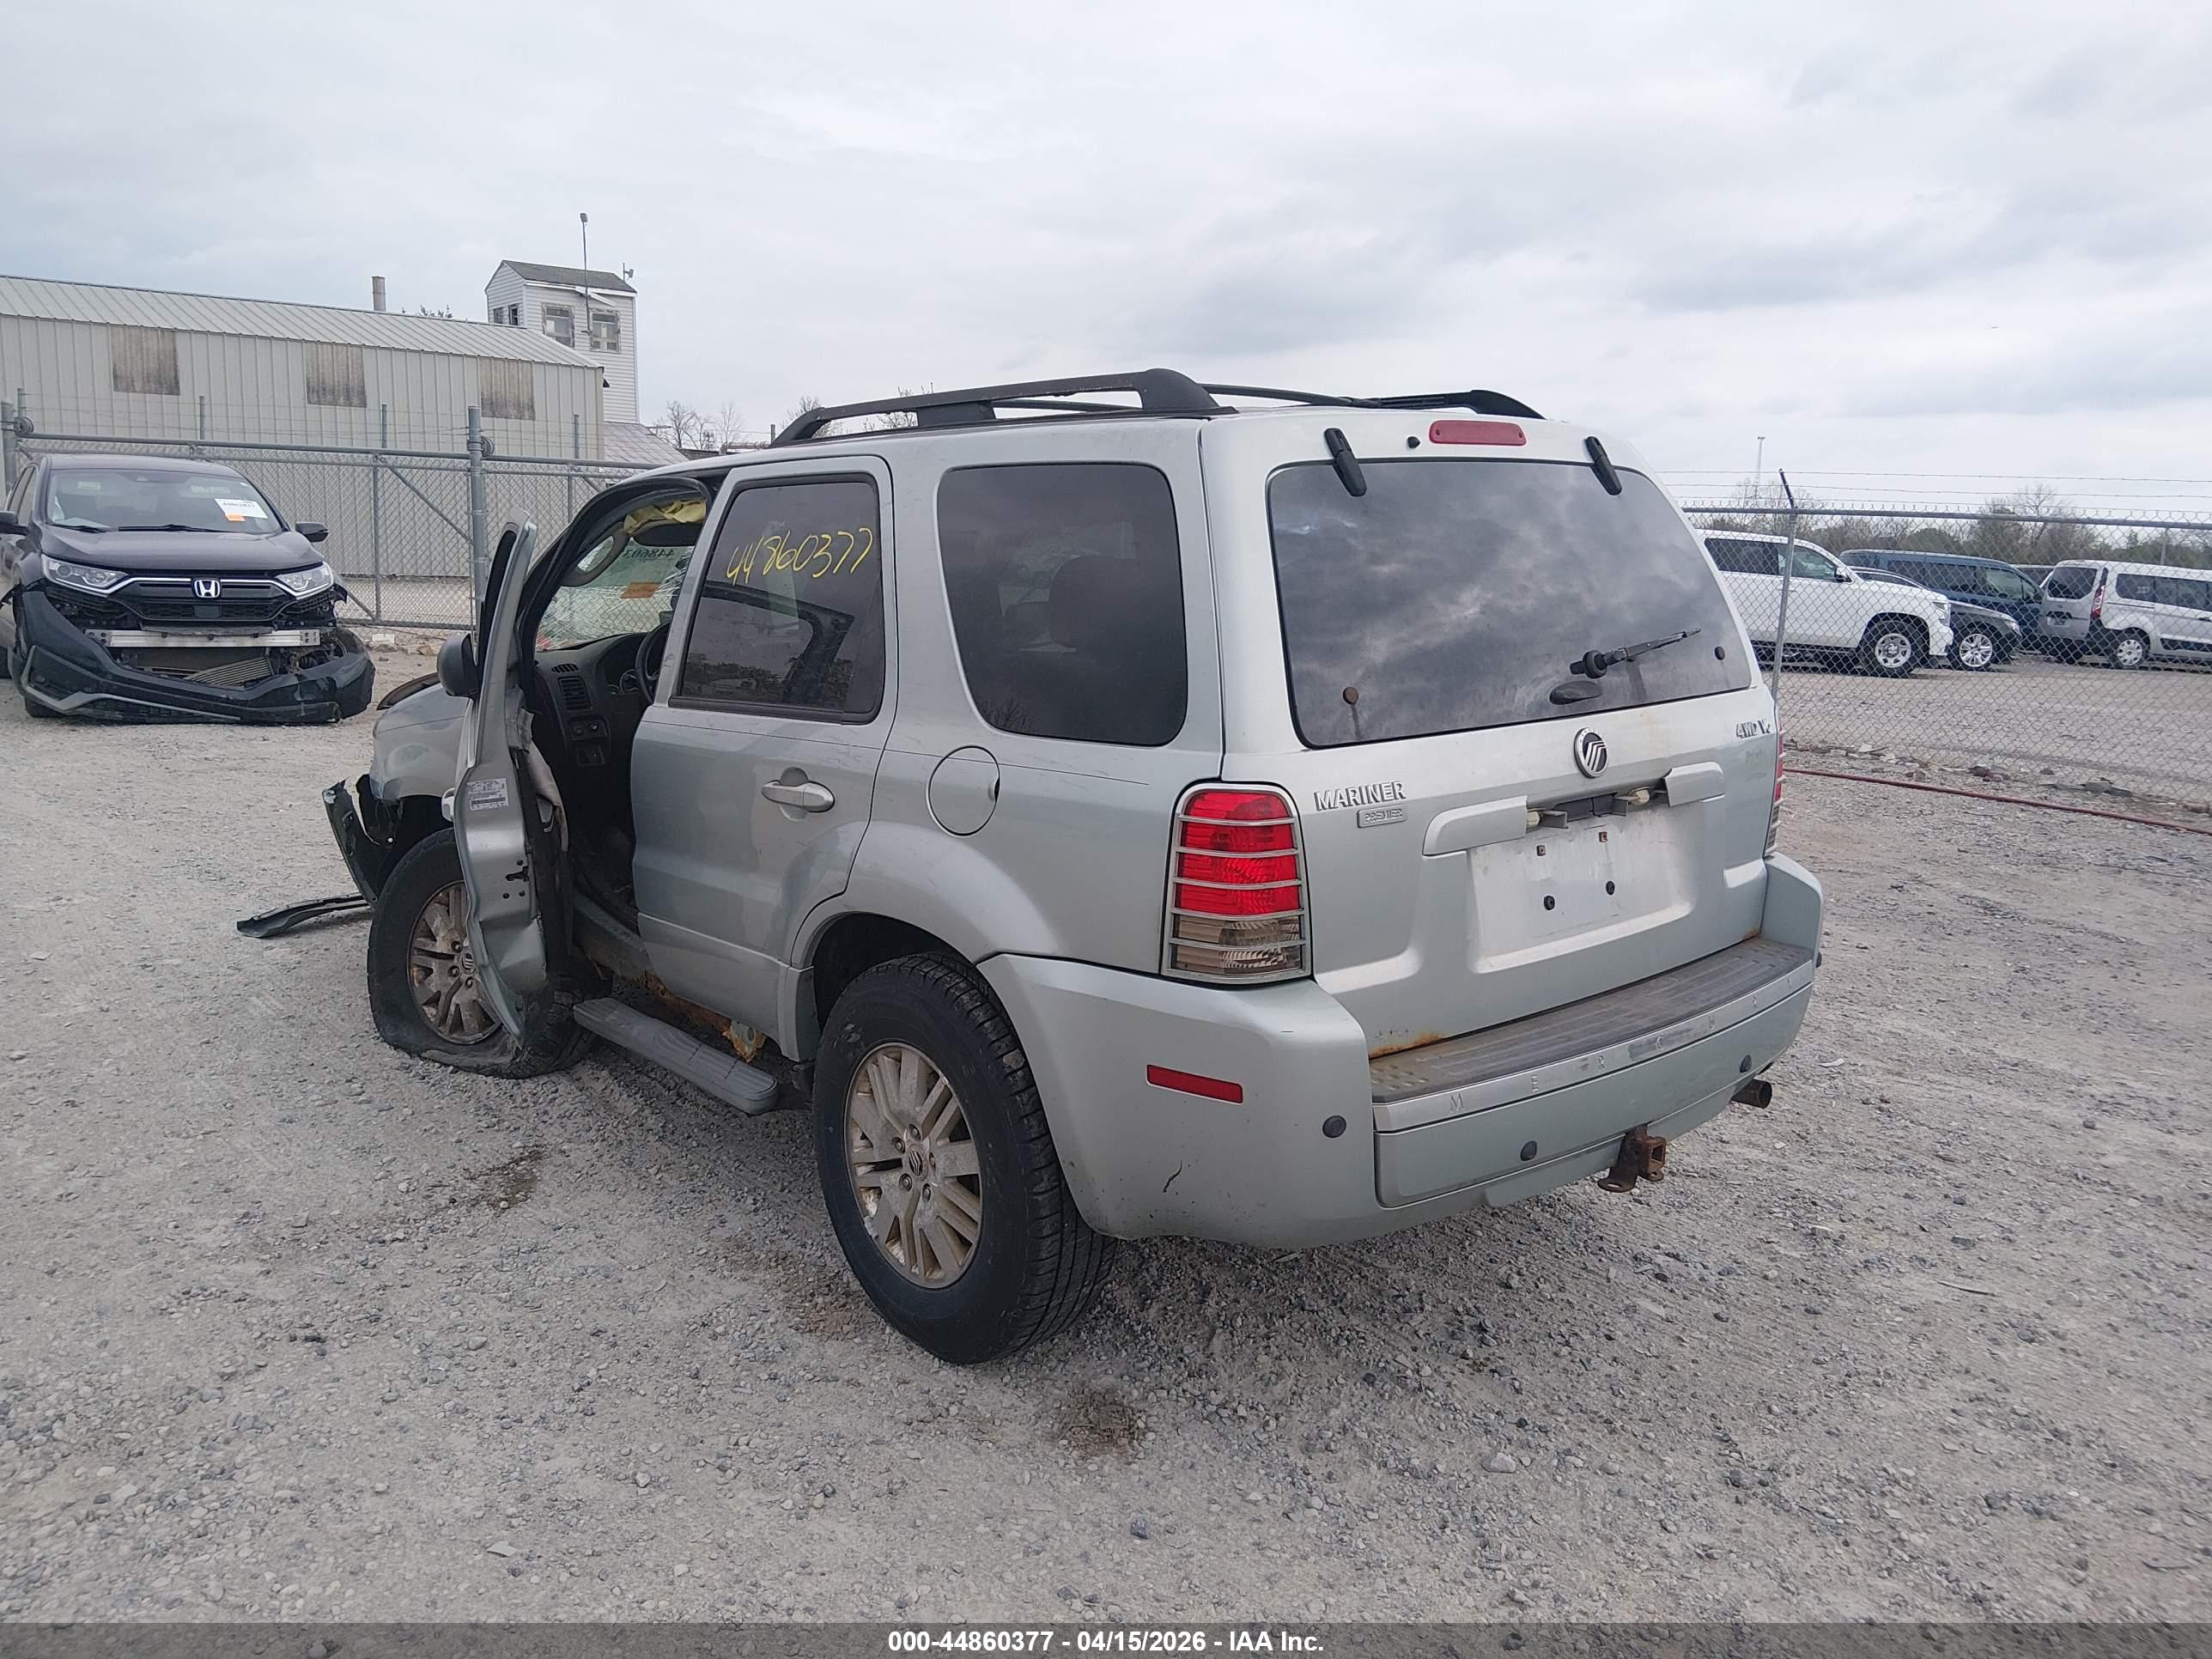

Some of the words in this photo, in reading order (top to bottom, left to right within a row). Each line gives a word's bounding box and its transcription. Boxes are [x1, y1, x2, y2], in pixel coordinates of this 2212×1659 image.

[726, 527, 873, 586] 44860377
[1313, 781, 1407, 811] MARINER
[1363, 807, 1404, 823] PREMIER
